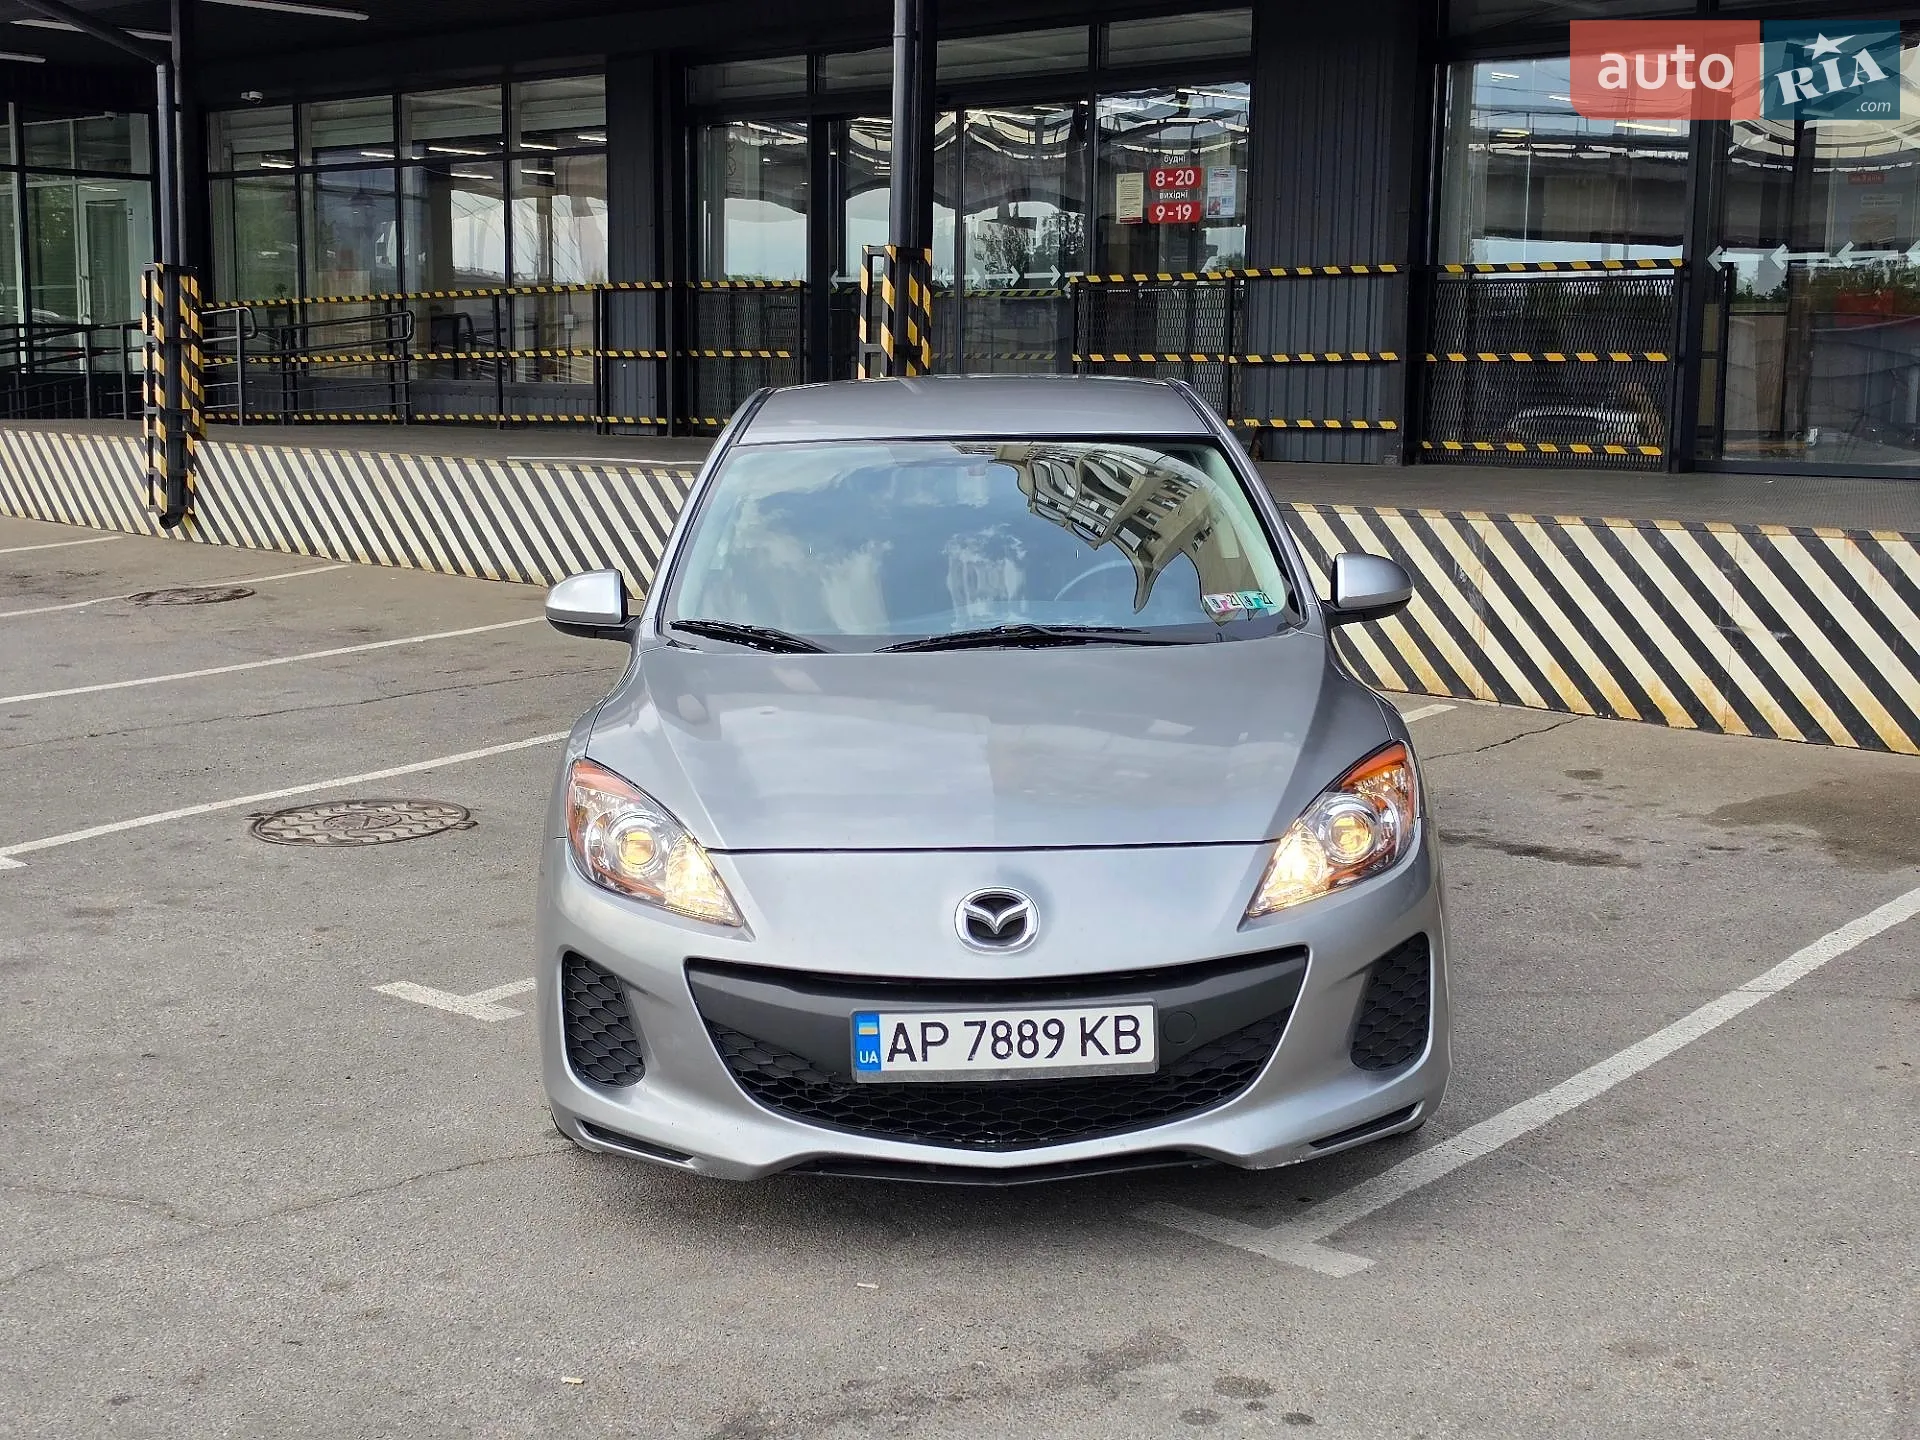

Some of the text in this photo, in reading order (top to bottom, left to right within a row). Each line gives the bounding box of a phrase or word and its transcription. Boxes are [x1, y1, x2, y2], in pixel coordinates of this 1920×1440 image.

[1163, 154, 1186, 164] будні
[1159, 190, 1189, 200] вихідні
[886, 1014, 1142, 1063] AP 7889 KB
[859, 1050, 879, 1064] UA
